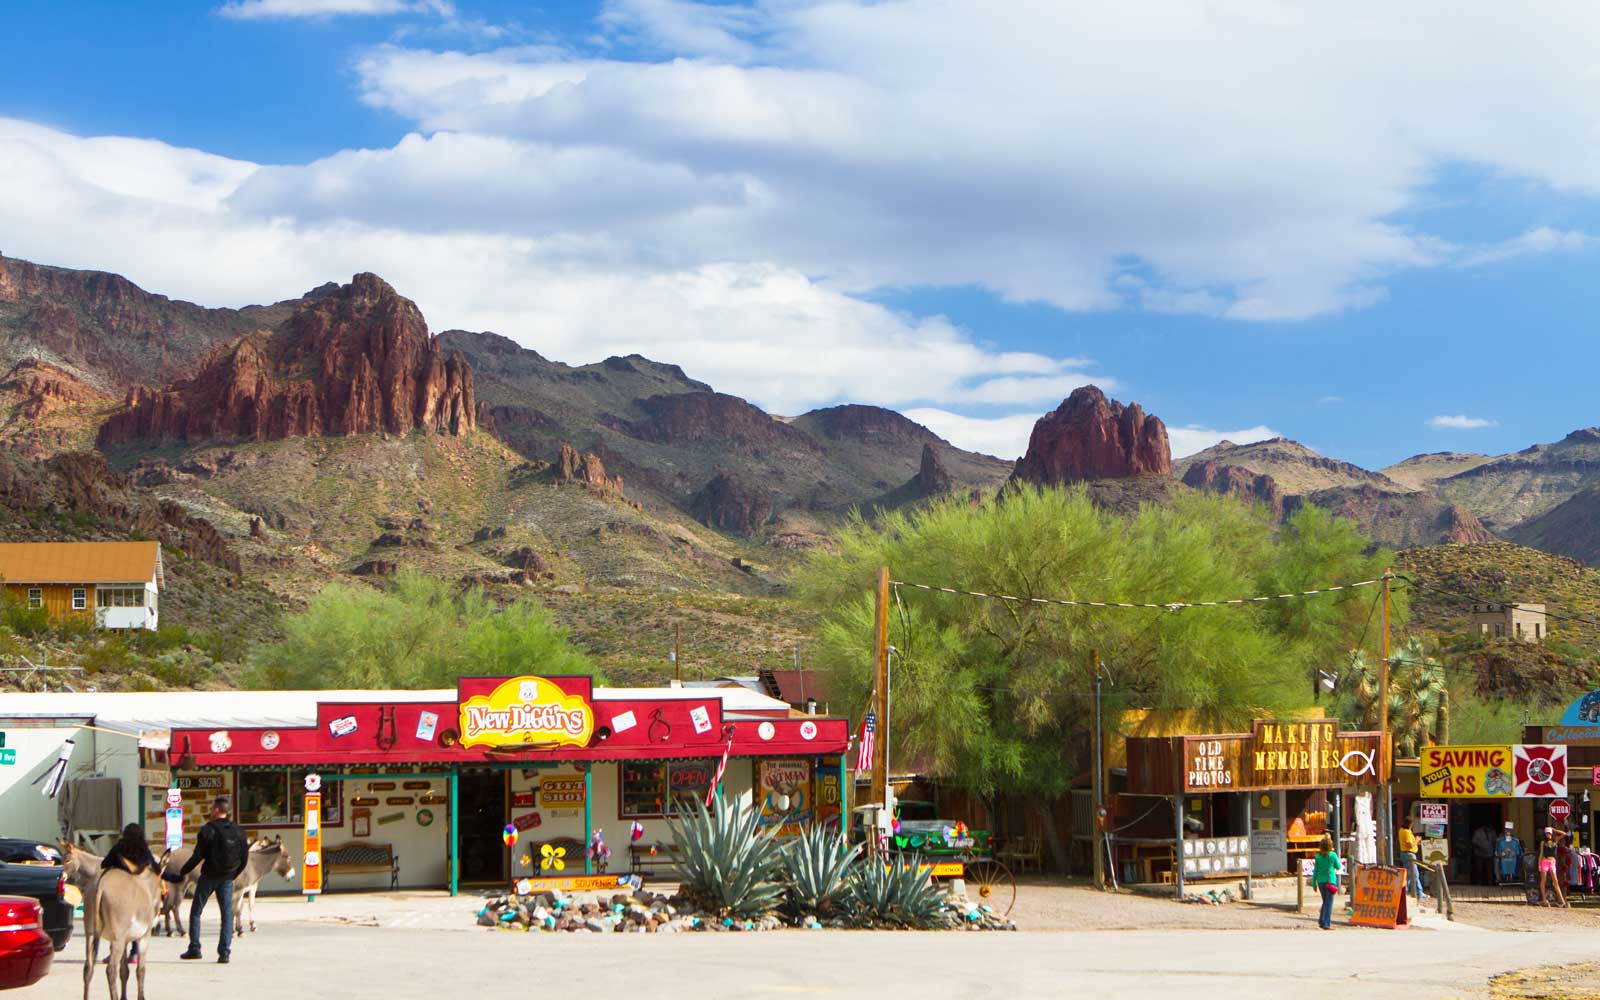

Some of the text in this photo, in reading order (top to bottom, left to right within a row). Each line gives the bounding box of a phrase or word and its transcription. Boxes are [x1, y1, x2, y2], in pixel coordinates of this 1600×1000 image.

[468, 707, 510, 737] New
[1263, 724, 1333, 744] MAKING
[1199, 741, 1222, 756] OLD
[1194, 756, 1225, 771] TIME
[1255, 750, 1340, 770] MEMORIES
[1429, 750, 1505, 768] SAVING
[198, 778, 221, 788] SIGNS
[671, 770, 707, 786] OPEN
[1189, 770, 1231, 786] PHOTOS
[1425, 768, 1450, 784] YOUR
[544, 782, 584, 790] GIFT
[1442, 775, 1476, 794] ASS
[1551, 806, 1569, 814] WHOA
[1367, 870, 1393, 886] OLD
[1363, 887, 1394, 903] TIME
[1354, 904, 1397, 919] PHOTOS
